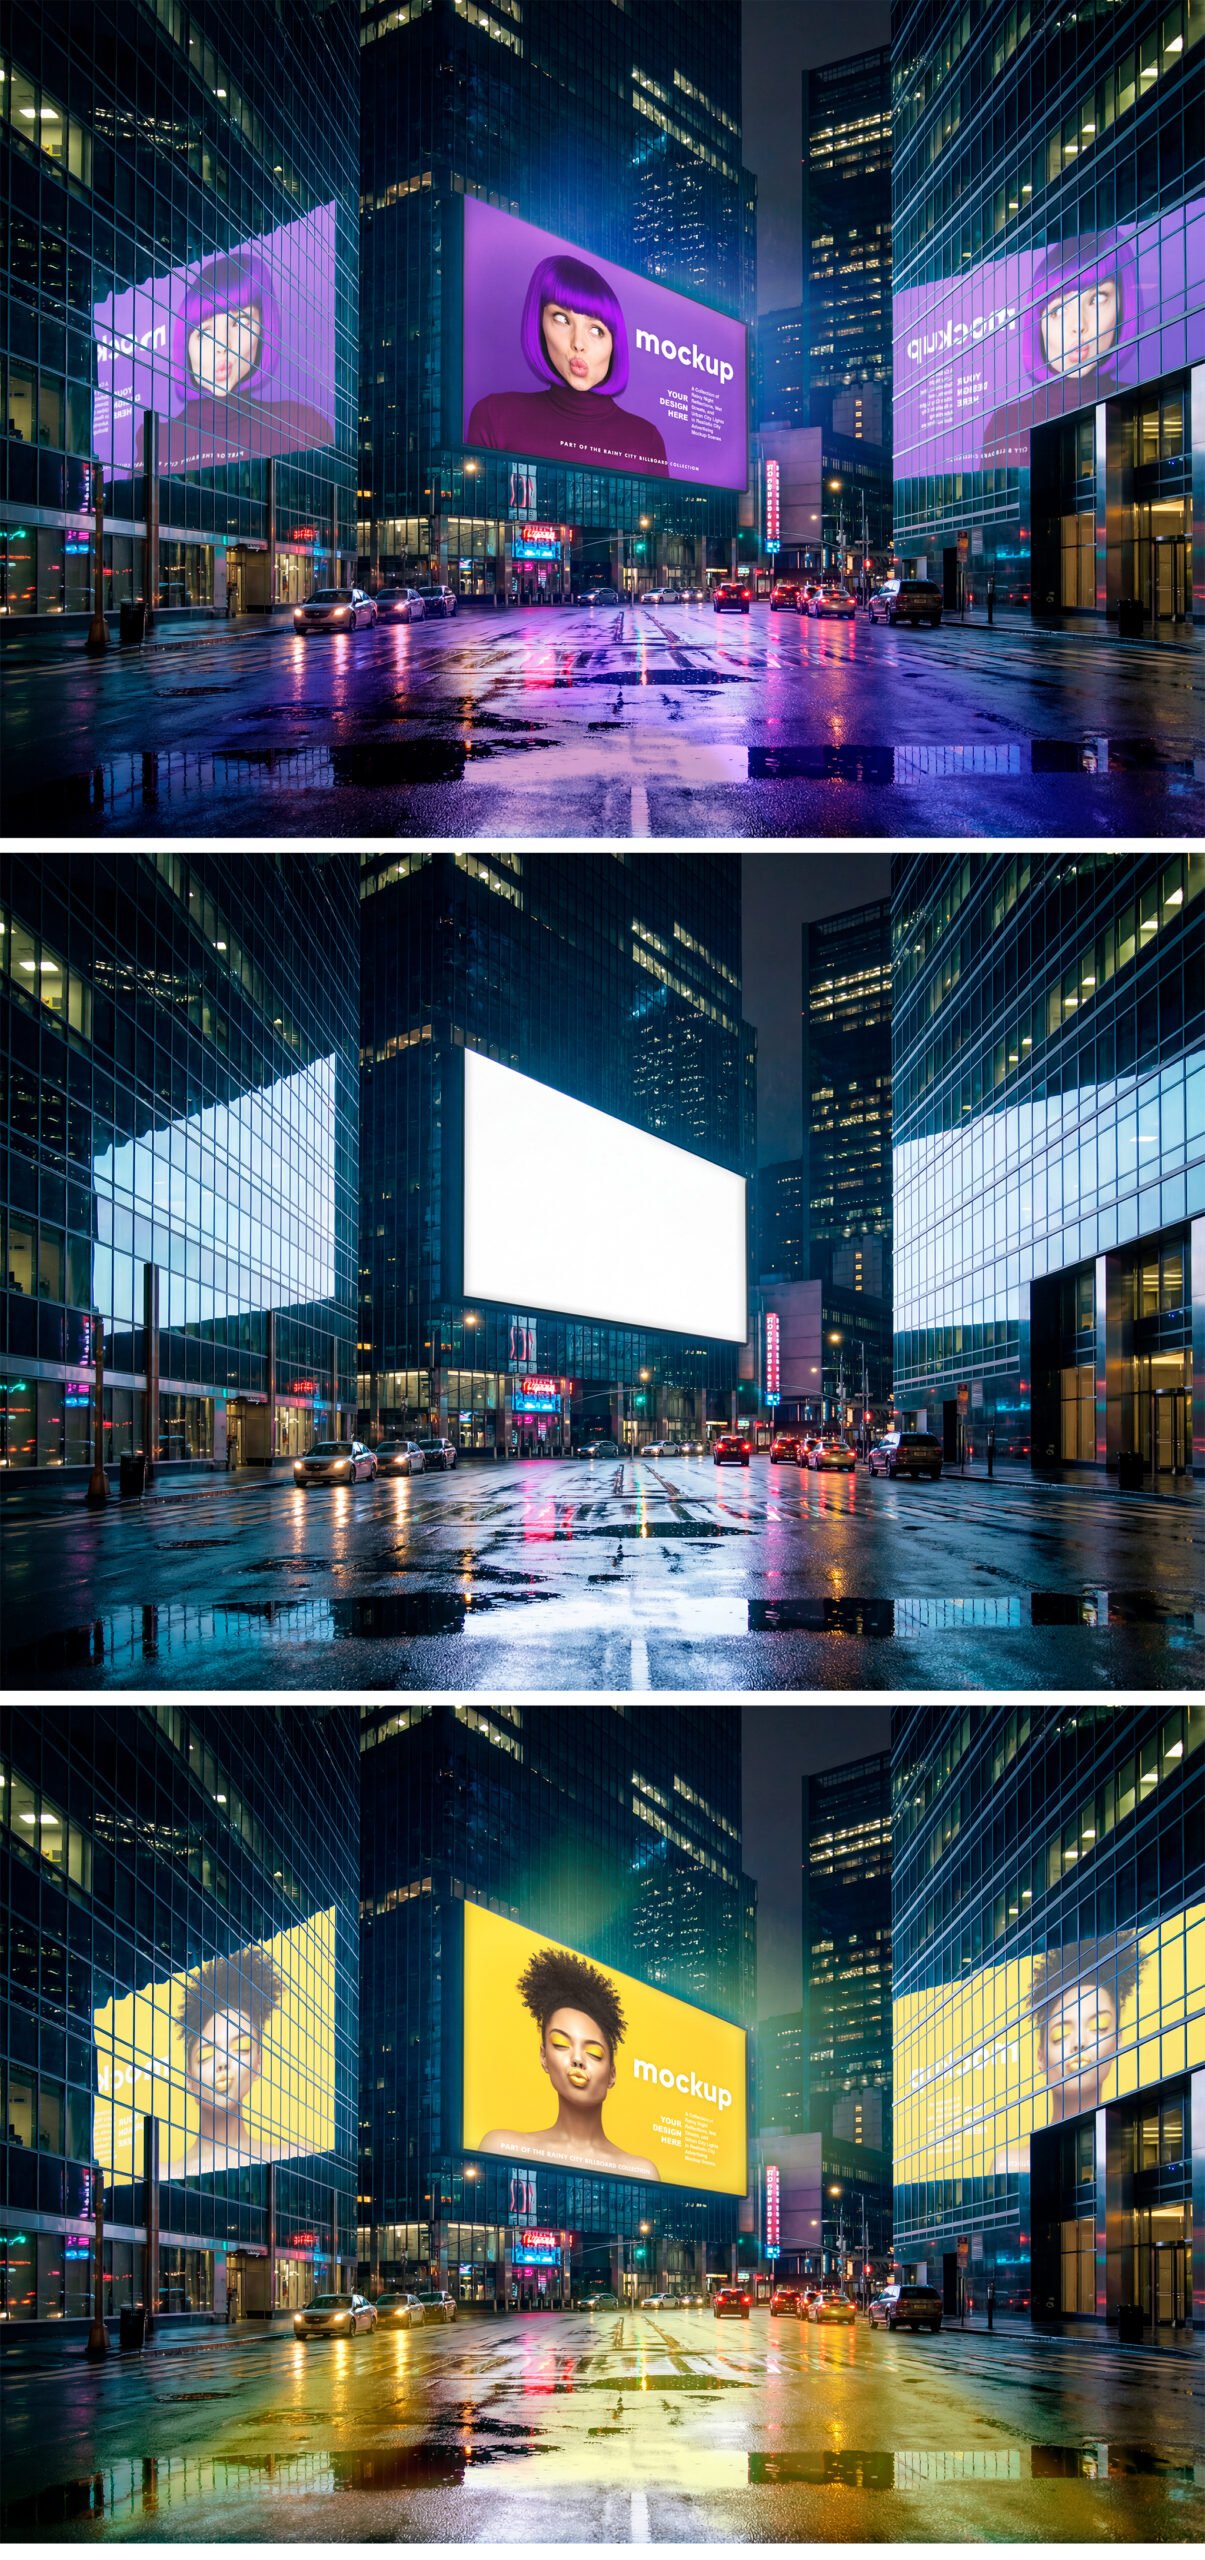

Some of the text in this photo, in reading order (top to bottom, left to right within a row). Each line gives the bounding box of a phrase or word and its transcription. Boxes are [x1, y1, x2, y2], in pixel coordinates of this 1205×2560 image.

[636, 328, 734, 384] mockup
[667, 390, 688, 402] YOUR
[660, 398, 688, 411] DESIGN
[668, 410, 688, 421] HERE
[560, 440, 577, 448] PART
[603, 448, 622, 457] RAINY
[639, 455, 668, 465] BILLBOARD
[670, 461, 700, 471] COLLECTION
[633, 2058, 732, 2110] mockup
[660, 2115, 682, 2128] YOUR
[652, 2124, 682, 2137] DESIGN
[661, 2136, 682, 2147] HERE
[500, 2143, 519, 2151] PART
[547, 2151, 568, 2160] RAINY
[569, 2155, 583, 2163] CITY
[585, 2158, 617, 2169] BILLBOARD
